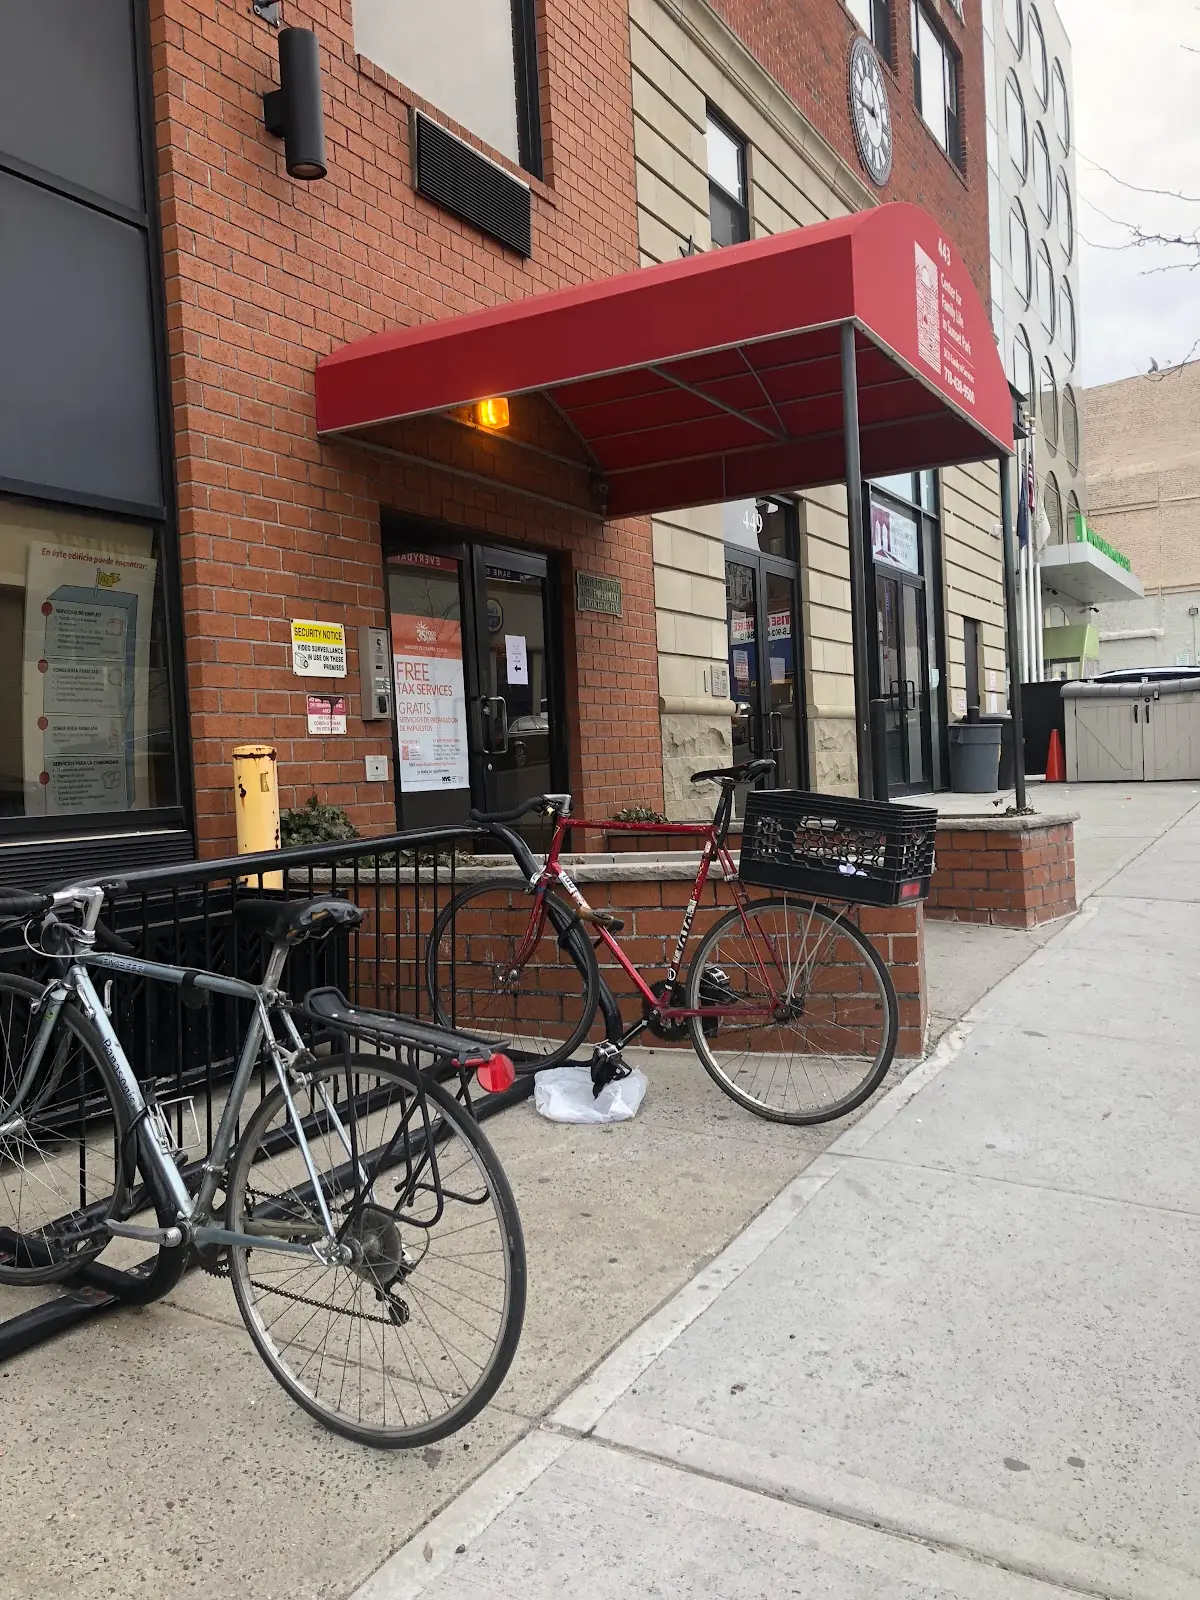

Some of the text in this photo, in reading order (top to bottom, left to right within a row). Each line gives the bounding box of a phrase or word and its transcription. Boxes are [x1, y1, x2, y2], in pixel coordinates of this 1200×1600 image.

[938, 237, 951, 266] 443
[940, 272, 955, 299] Center
[941, 293, 956, 322] Family
[742, 509, 763, 534] 449
[41, 547, 51, 556] En
[68, 552, 93, 562] edificio
[93, 556, 114, 566] puede
[294, 626, 343, 641] SECURITY NOTICE
[297, 644, 344, 655] VIDEO SURVEILLANCE
[307, 653, 313, 661] IN
[313, 654, 322, 662] USE
[330, 655, 344, 663] THESE
[323, 663, 345, 672] PREMISES
[396, 661, 430, 682] FREE
[396, 682, 453, 697] TAX SERVICES
[398, 702, 432, 715] GRATIS
[399, 716, 424, 724] SERVICIOS
[423, 716, 430, 724] DE
[399, 724, 433, 732] DE IMPUESTOS
[102, 1037, 136, 1104] Panasonic
